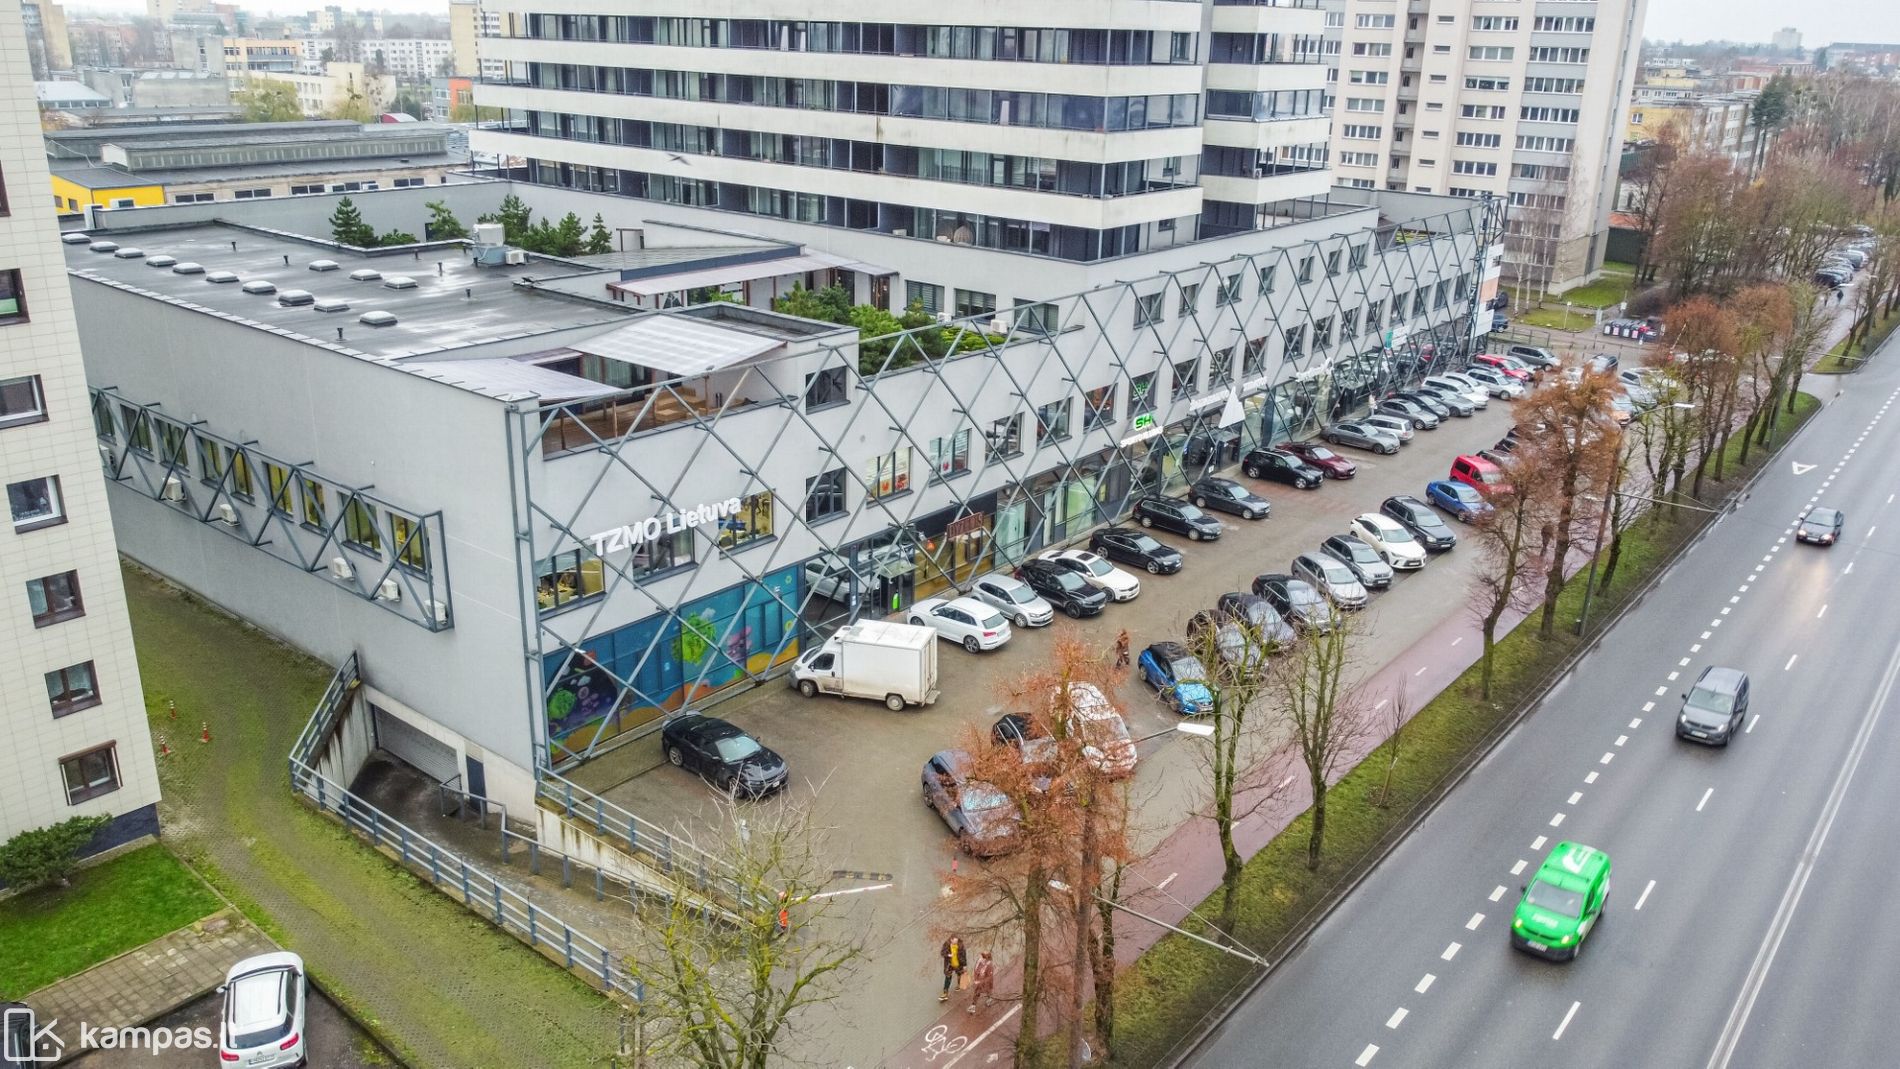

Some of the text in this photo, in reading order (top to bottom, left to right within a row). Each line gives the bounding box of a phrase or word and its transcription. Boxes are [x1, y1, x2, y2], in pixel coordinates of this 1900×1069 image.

[1134, 413, 1153, 431] SH
[590, 497, 742, 556] TZMO Lietuva
